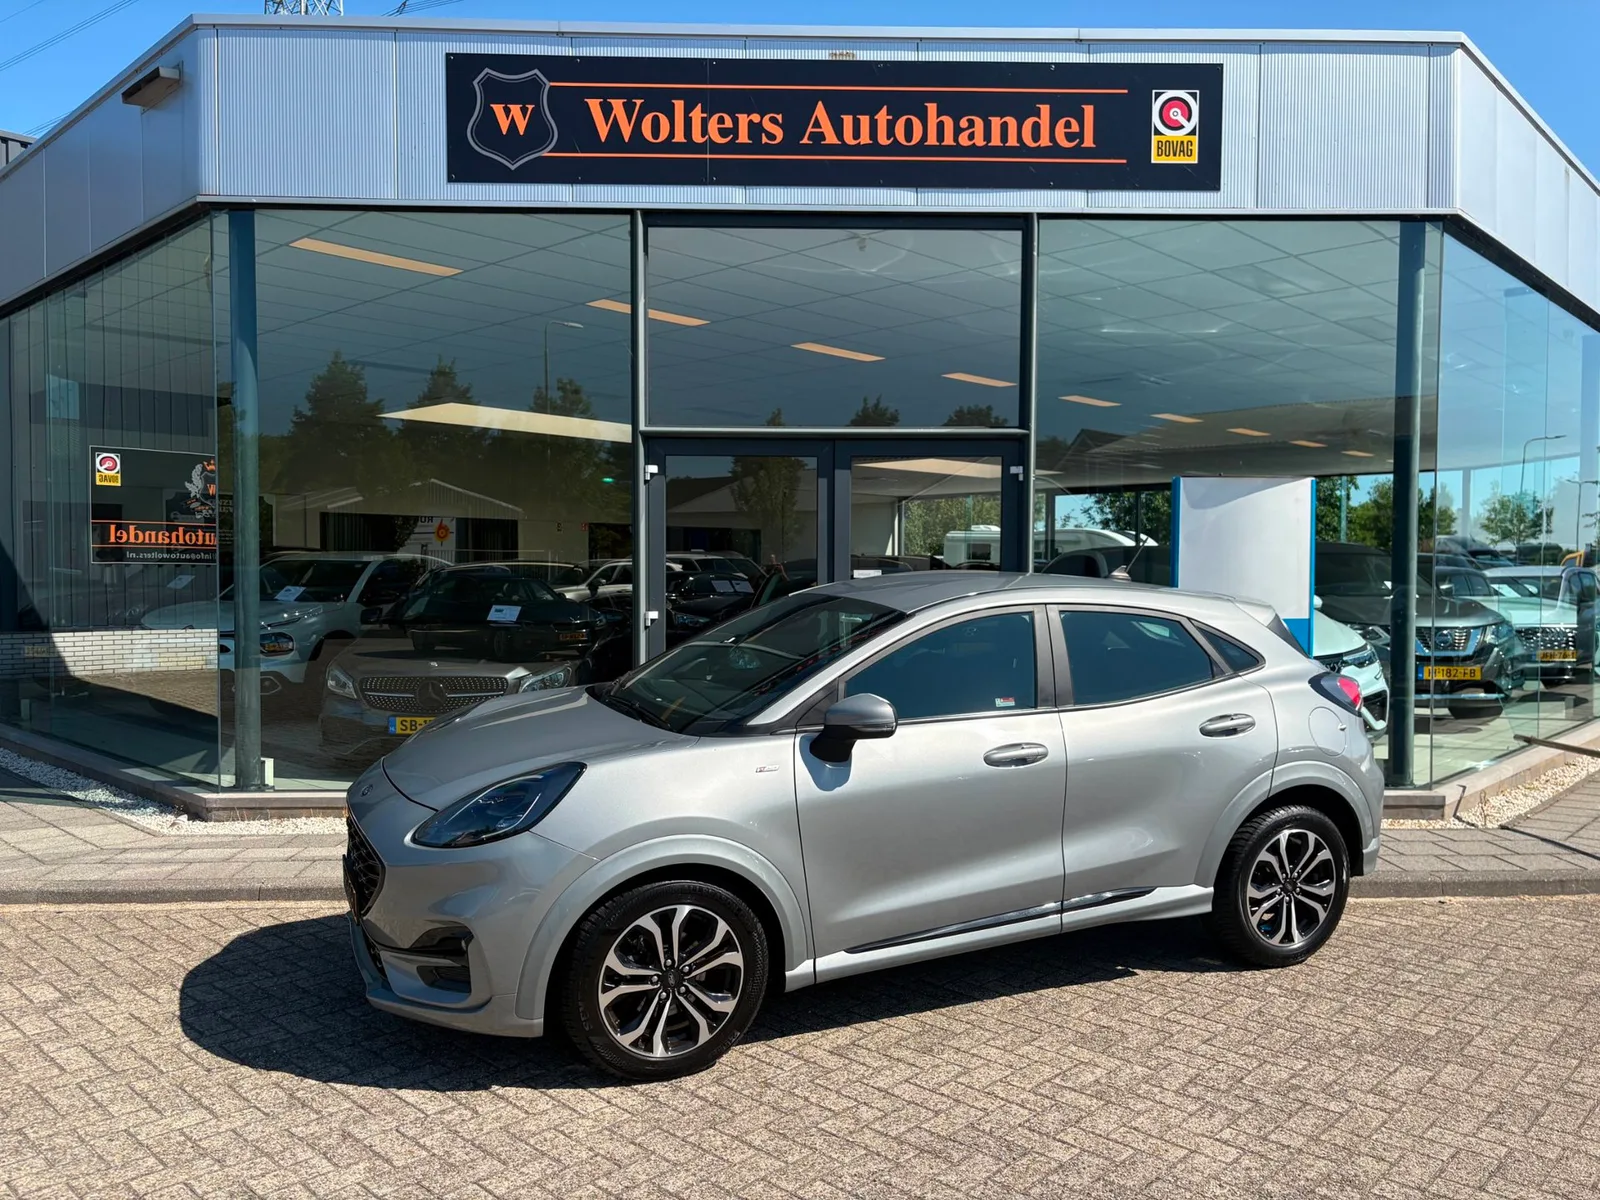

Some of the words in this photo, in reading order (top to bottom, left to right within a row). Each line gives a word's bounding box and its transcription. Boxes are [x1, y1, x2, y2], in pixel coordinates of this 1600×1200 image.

[490, 104, 535, 136] W
[584, 98, 784, 144] Wolters
[800, 100, 1096, 148] Autohandel
[1156, 140, 1193, 158] BOVAG
